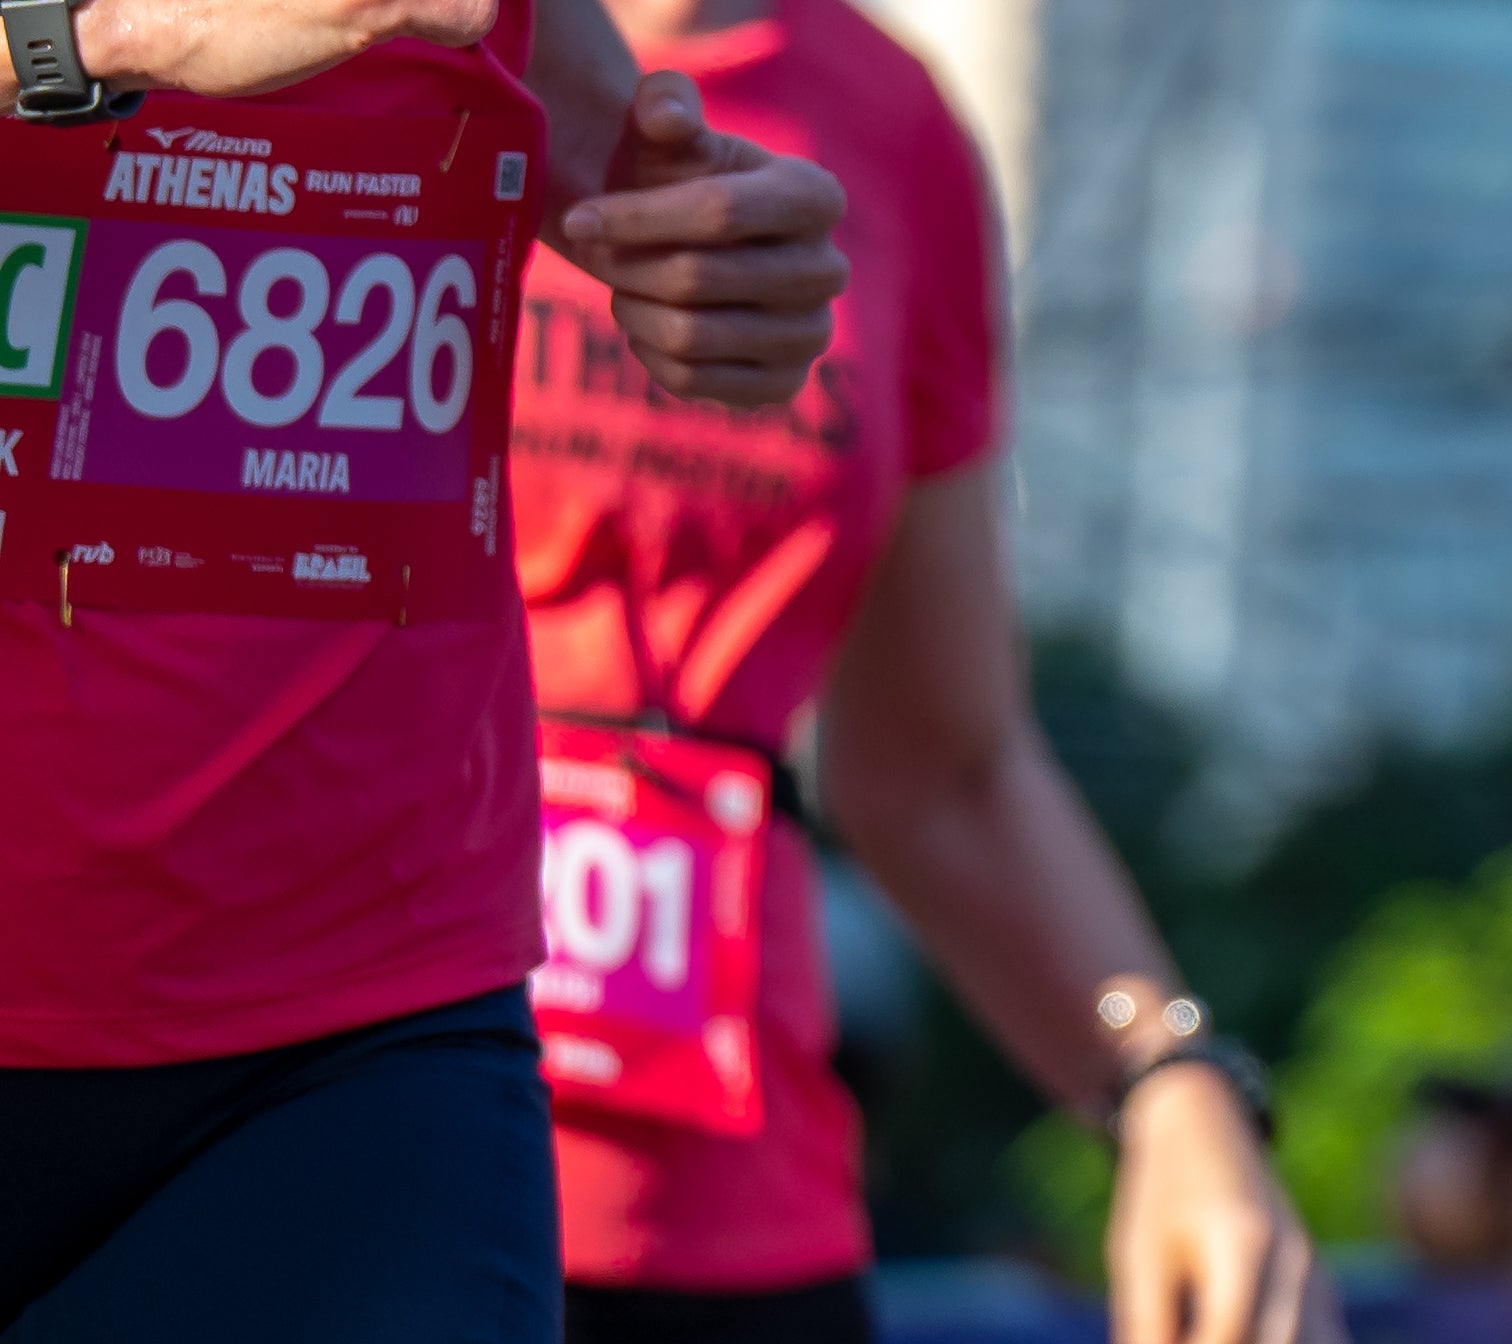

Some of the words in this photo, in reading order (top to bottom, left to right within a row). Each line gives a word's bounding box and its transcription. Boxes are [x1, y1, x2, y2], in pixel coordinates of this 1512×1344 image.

[104, 150, 299, 215] ATHENAS
[306, 169, 351, 194] RUN
[355, 173, 421, 197] FASTER
[115, 238, 478, 433] 6826
[0, 428, 24, 477] K
[241, 447, 350, 493] MARIA
[545, 819, 696, 994] 01
